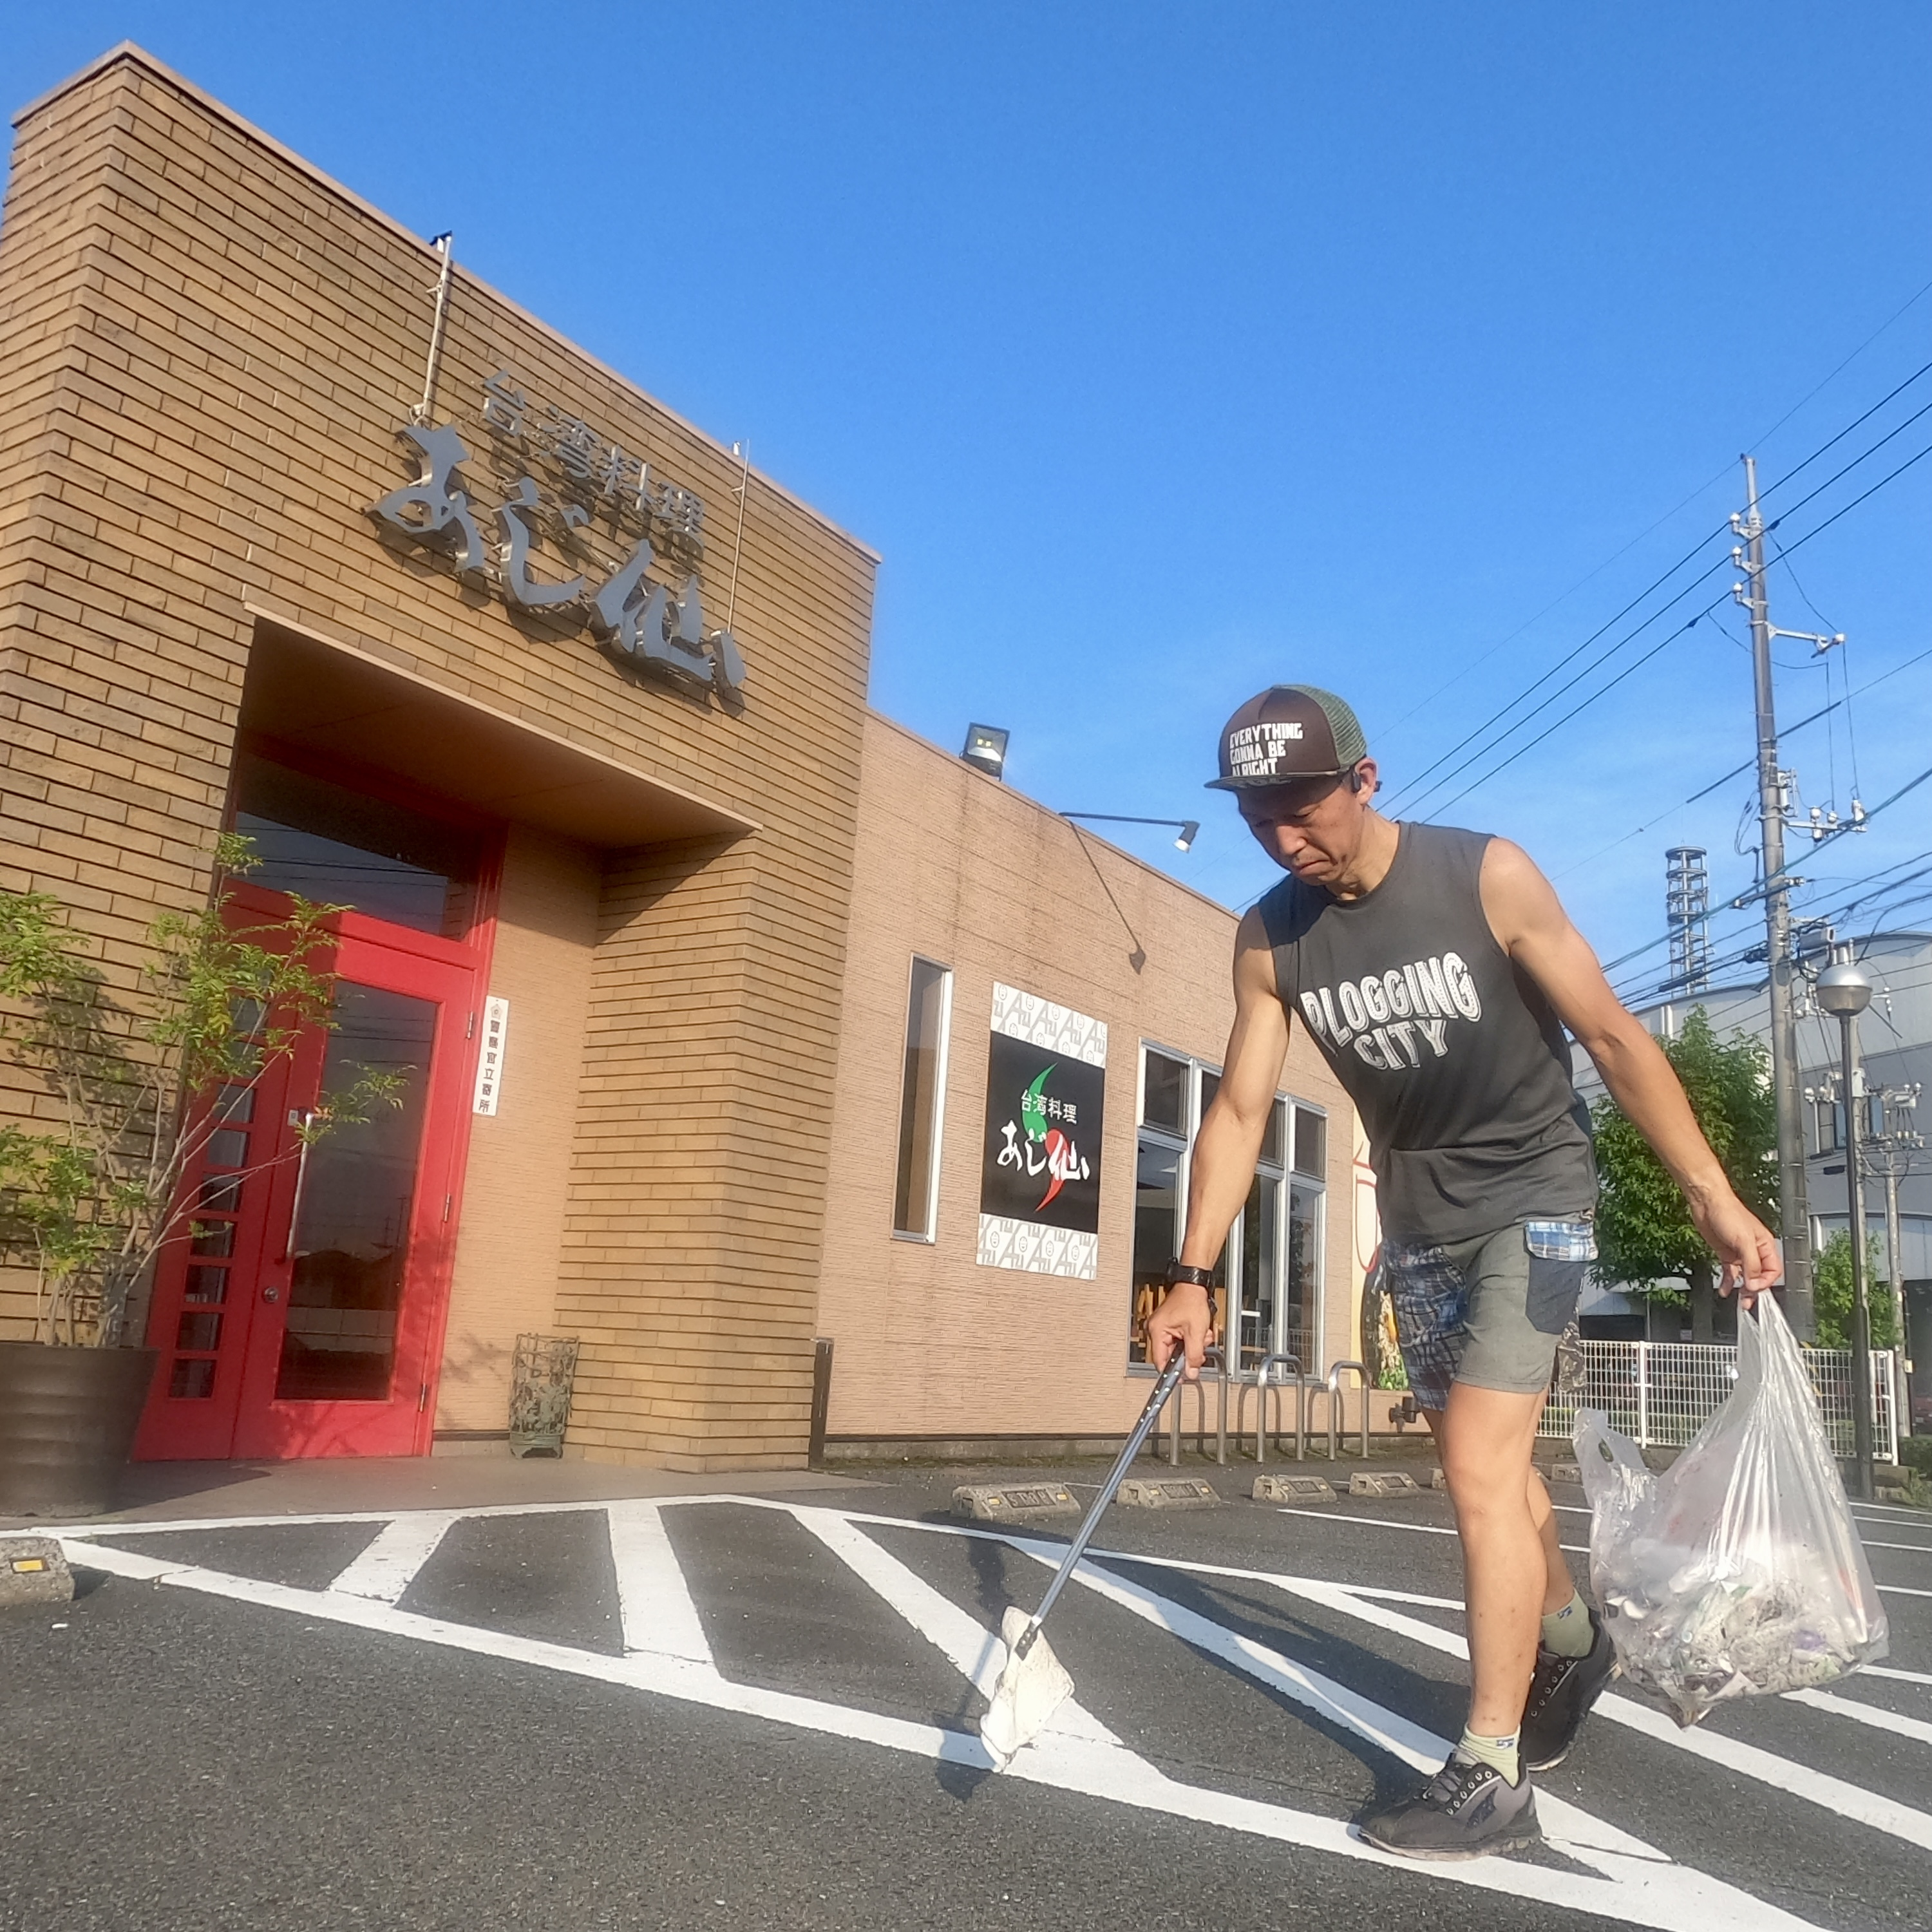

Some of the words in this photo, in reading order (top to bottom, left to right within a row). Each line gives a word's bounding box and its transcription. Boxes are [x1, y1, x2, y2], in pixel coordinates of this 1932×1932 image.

[1230, 723, 1303, 748] EVERYTHING
[1230, 743, 1264, 765] GONNA
[1267, 740, 1287, 758] BE
[1233, 758, 1278, 776] ALRIGHT
[1300, 951, 1482, 1057] PLOGGING
[1354, 1019, 1449, 1070] CITY
